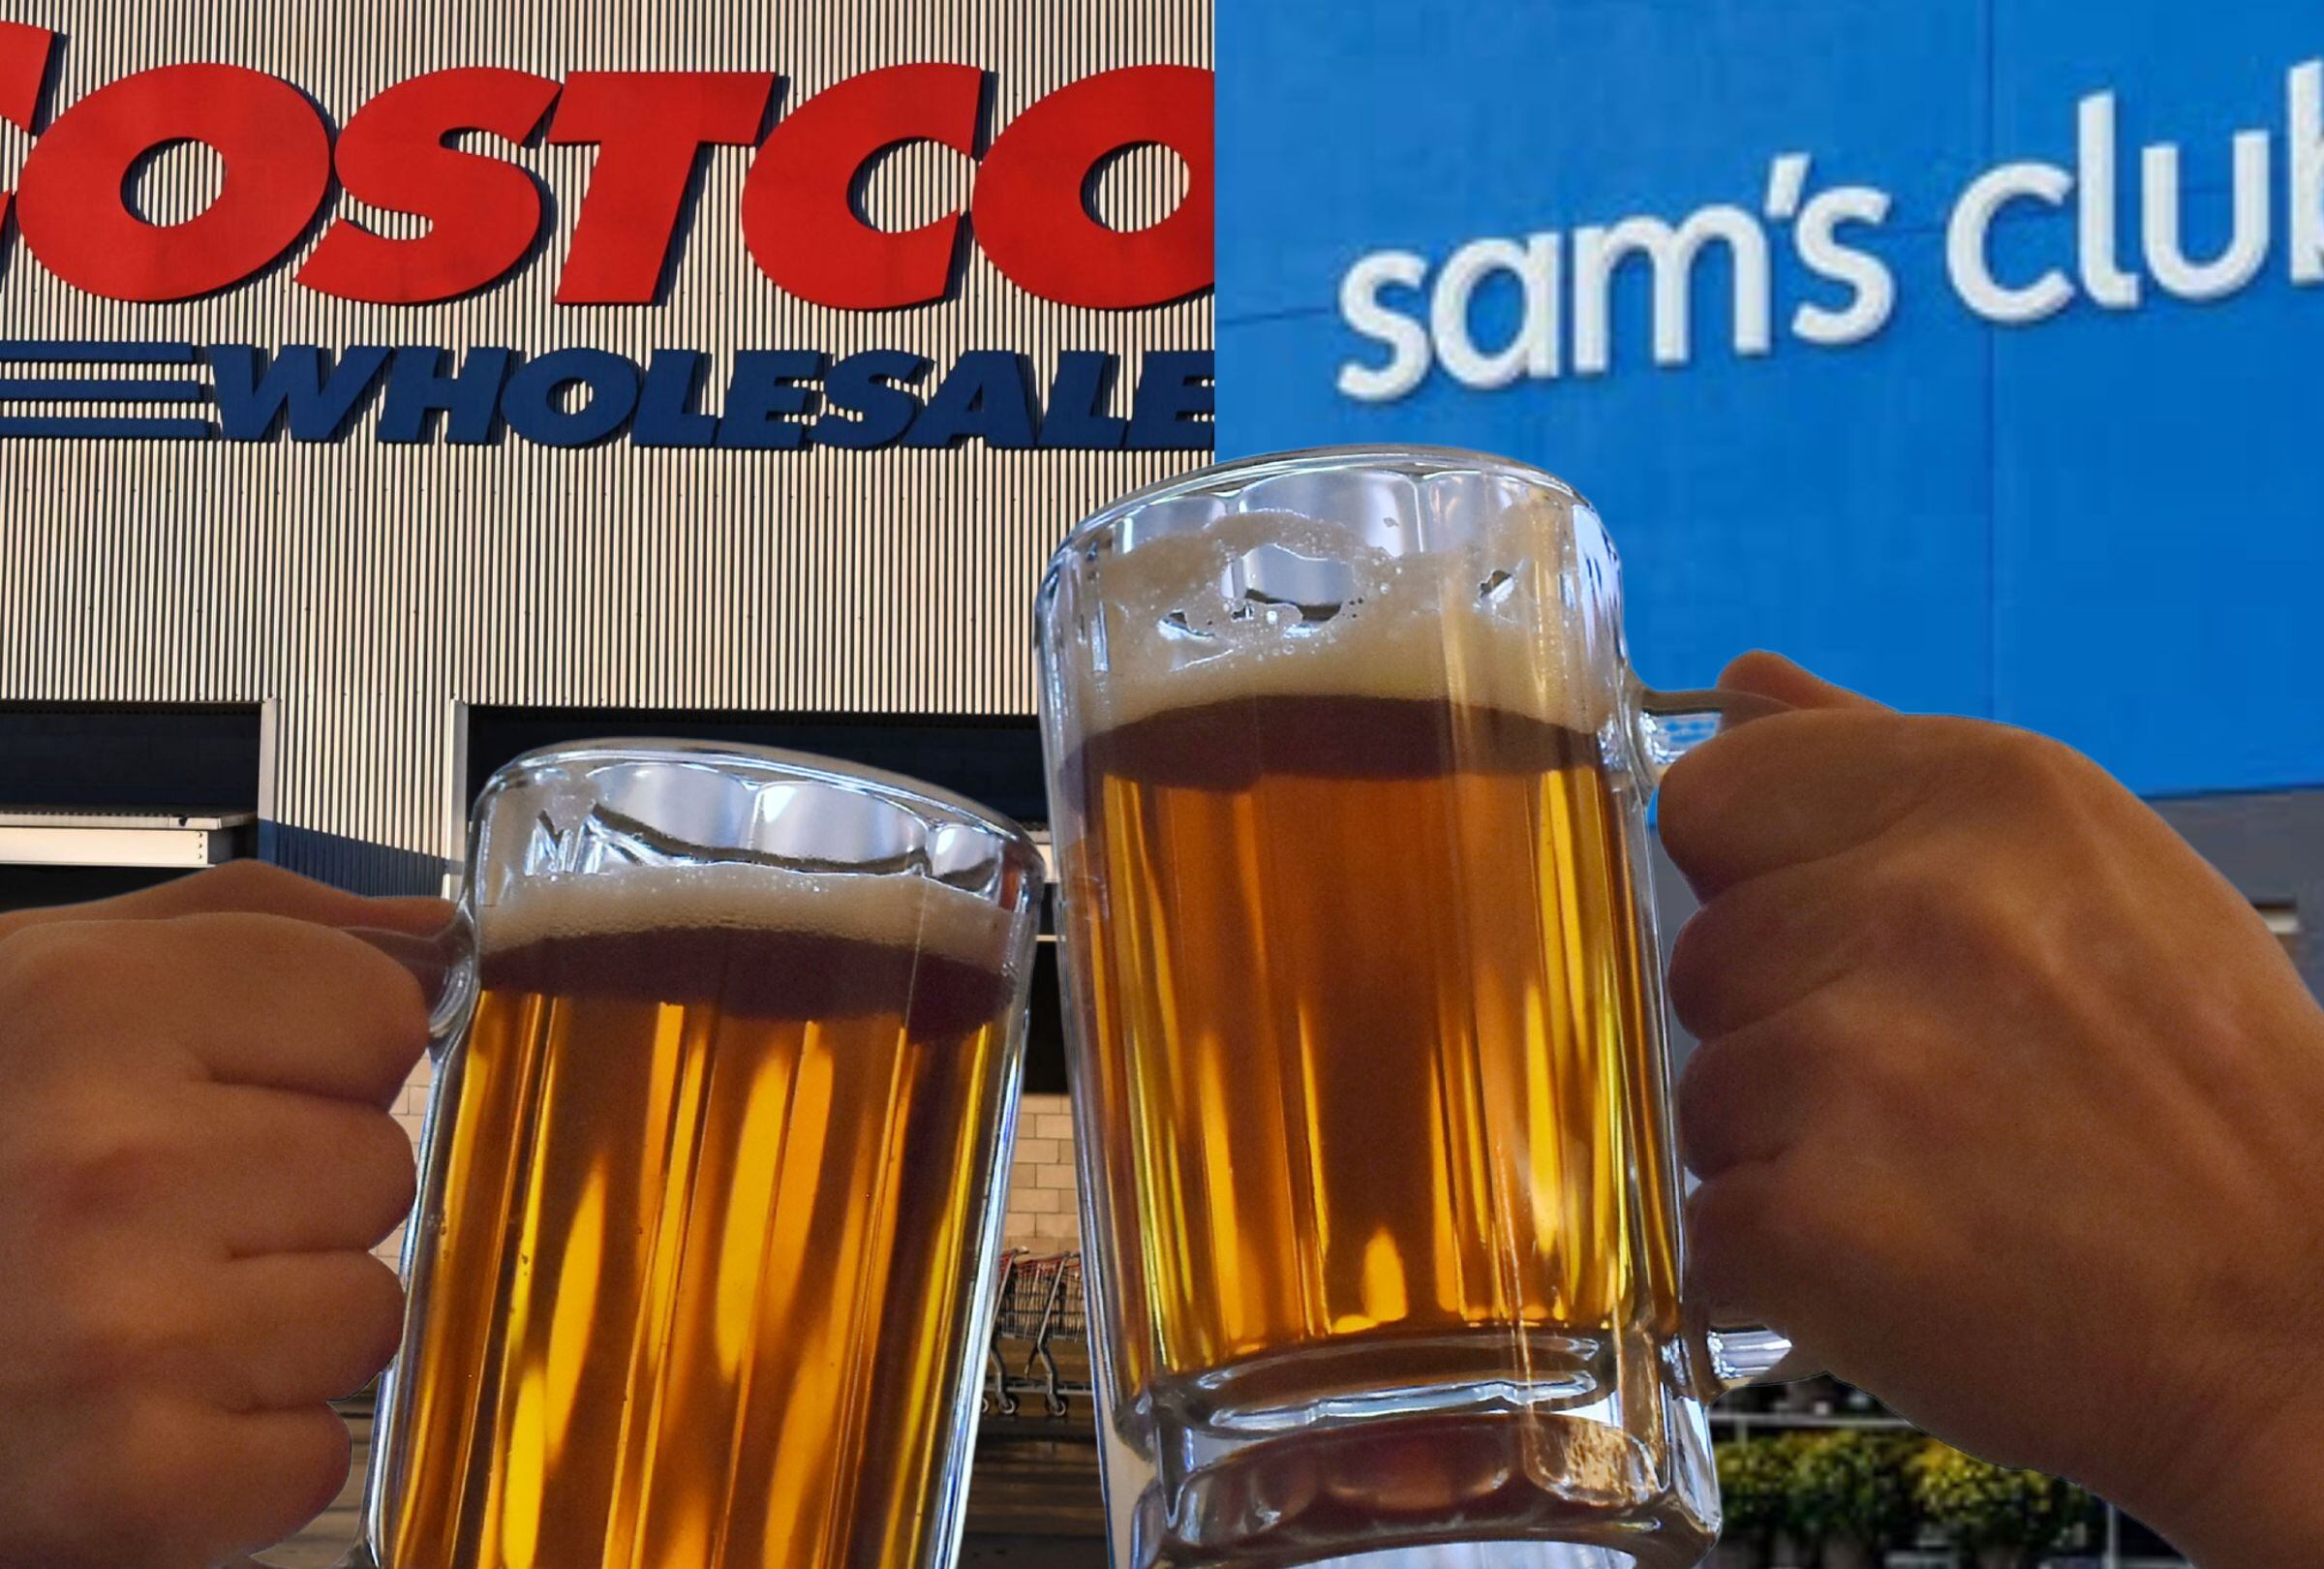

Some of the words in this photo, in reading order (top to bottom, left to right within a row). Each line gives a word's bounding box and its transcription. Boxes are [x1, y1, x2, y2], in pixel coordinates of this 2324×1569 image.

[0, 21, 1214, 310] OSTCO
[1338, 153, 1894, 403] sam's
[211, 344, 1214, 450] WHOLESALE
